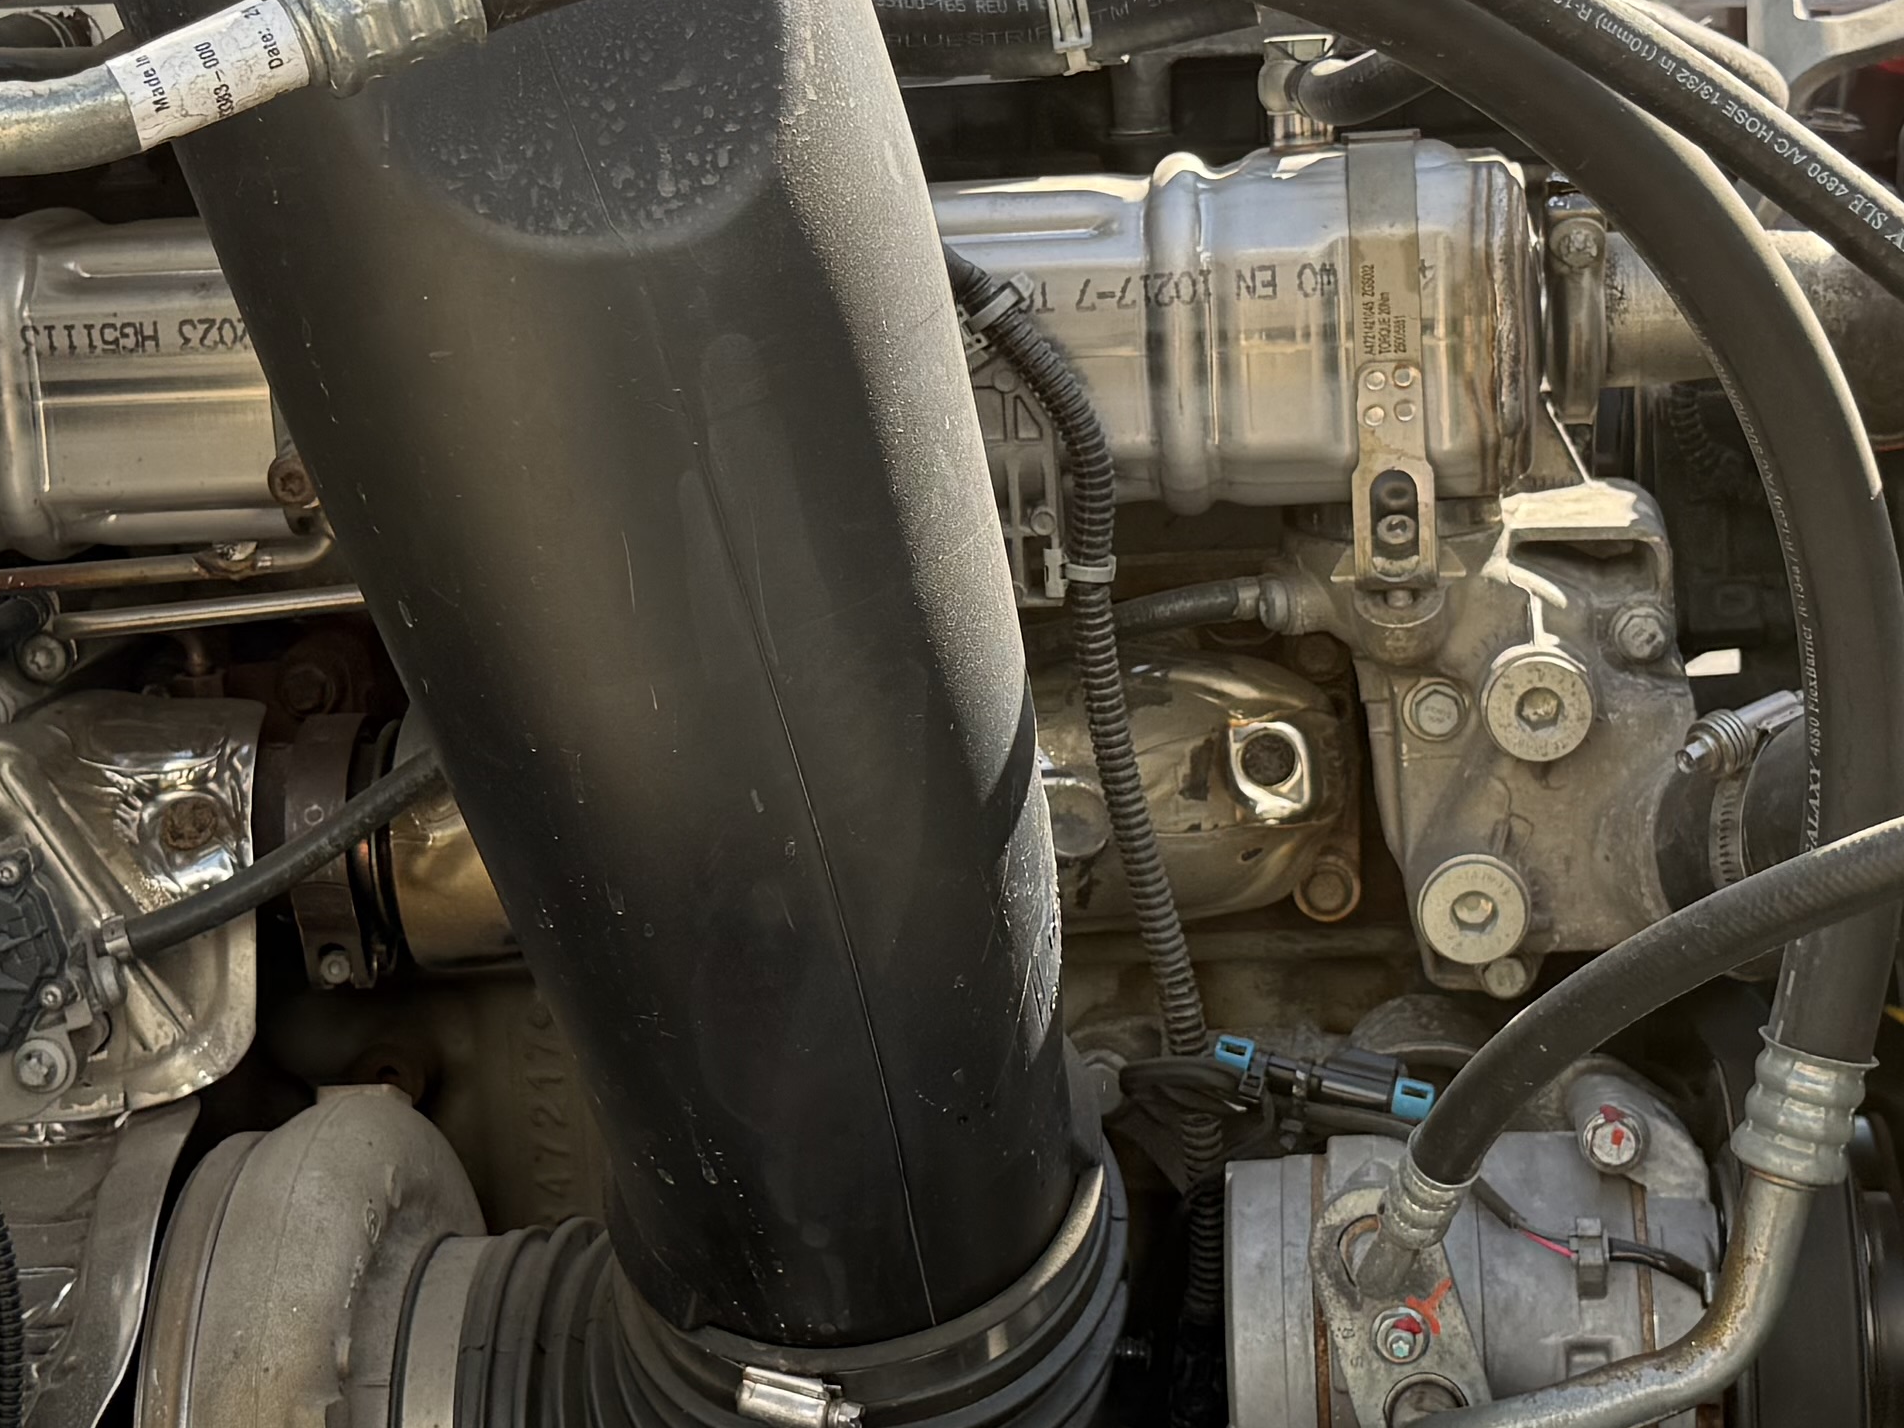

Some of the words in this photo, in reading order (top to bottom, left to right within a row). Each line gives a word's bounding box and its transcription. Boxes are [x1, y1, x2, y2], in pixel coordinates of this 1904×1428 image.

[258, 26, 284, 70] Date:
[1594, 12, 1658, 62] (10mm)
[142, 66, 171, 113] Made
[1675, 67, 1722, 106] 13/32
[1721, 99, 1775, 144] HOSE
[1773, 137, 1808, 166] A/C
[1807, 162, 1850, 198] 4890
[1847, 193, 1889, 230] SLE
[1075, 269, 1212, 313] 10217-7
[1235, 264, 1278, 301] EN
[1377, 317, 1392, 355] TORQUE
